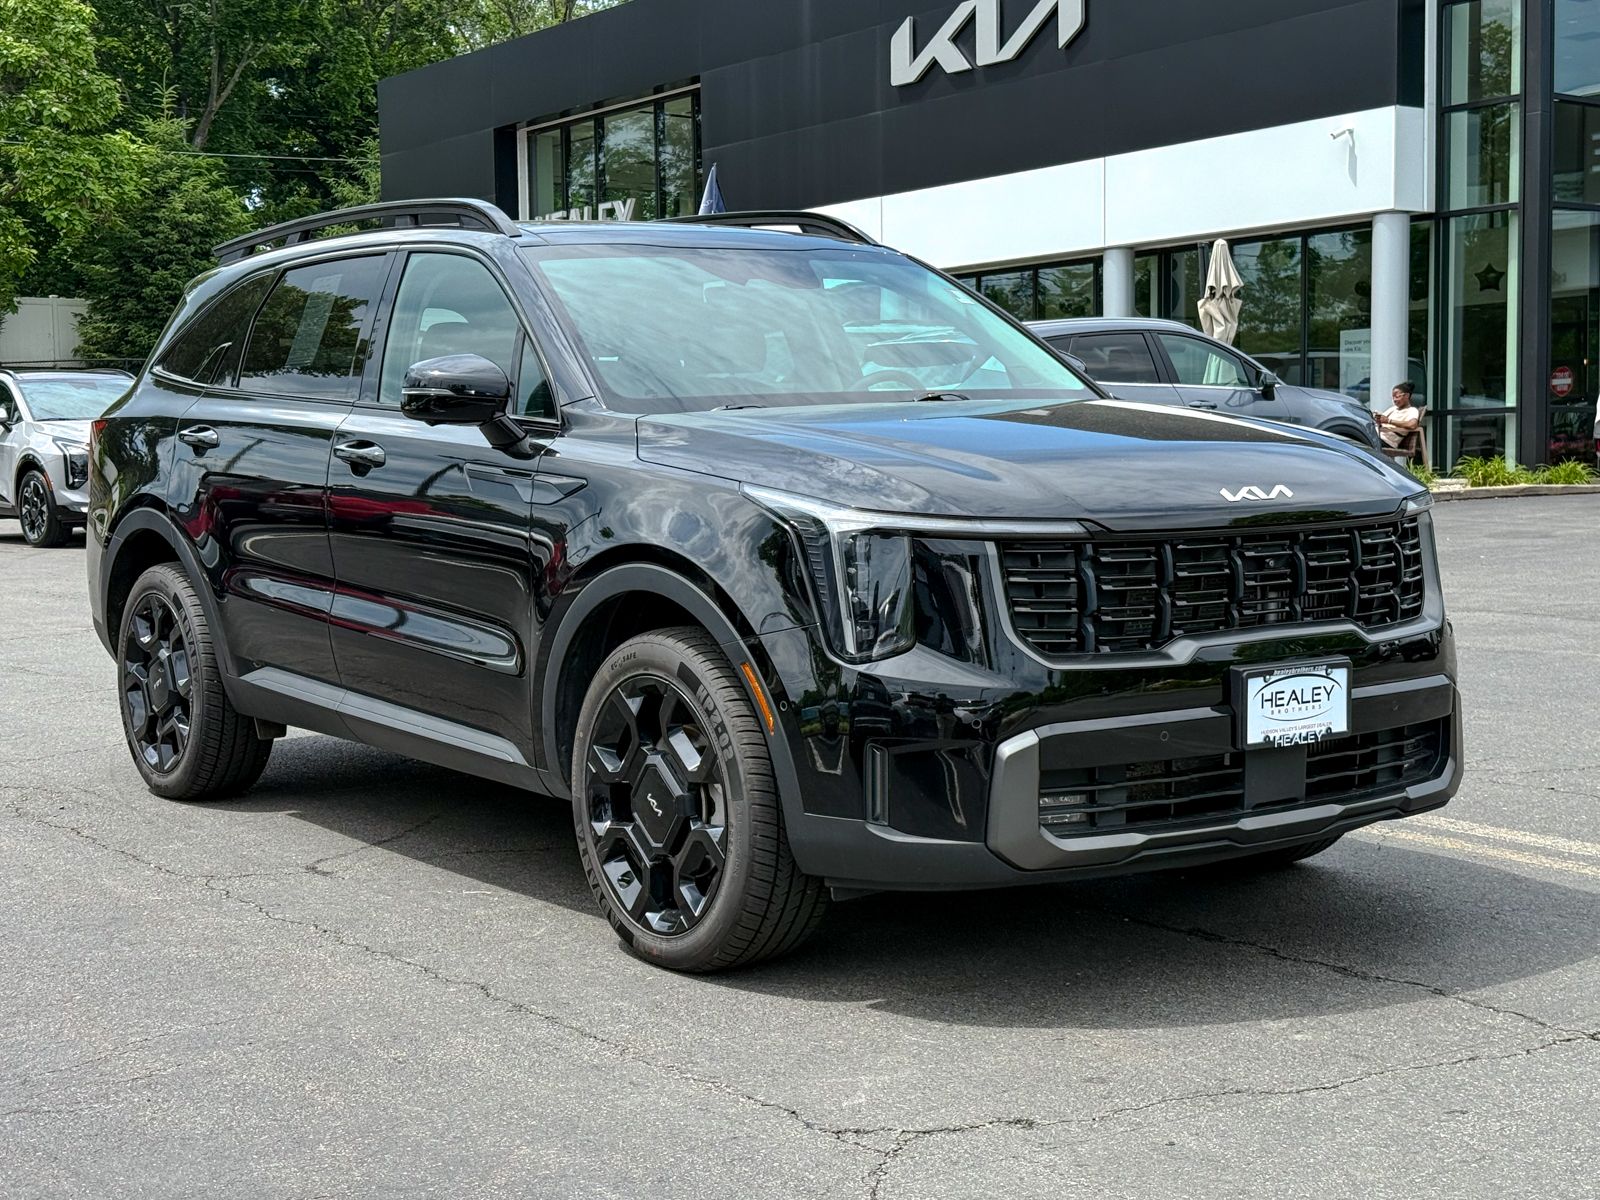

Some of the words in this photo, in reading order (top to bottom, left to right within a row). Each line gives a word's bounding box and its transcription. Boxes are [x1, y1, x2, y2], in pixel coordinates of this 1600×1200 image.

[891, 0, 1084, 86] KIA
[535, 198, 636, 221] ALEY
[1220, 484, 1294, 502] KIA
[1273, 665, 1327, 676] healeybrothers.com
[1261, 684, 1335, 709] HEALEY
[1271, 704, 1322, 715] BROTHERS
[1298, 723, 1316, 731] LARGEST
[1274, 730, 1323, 748] HEALEY
